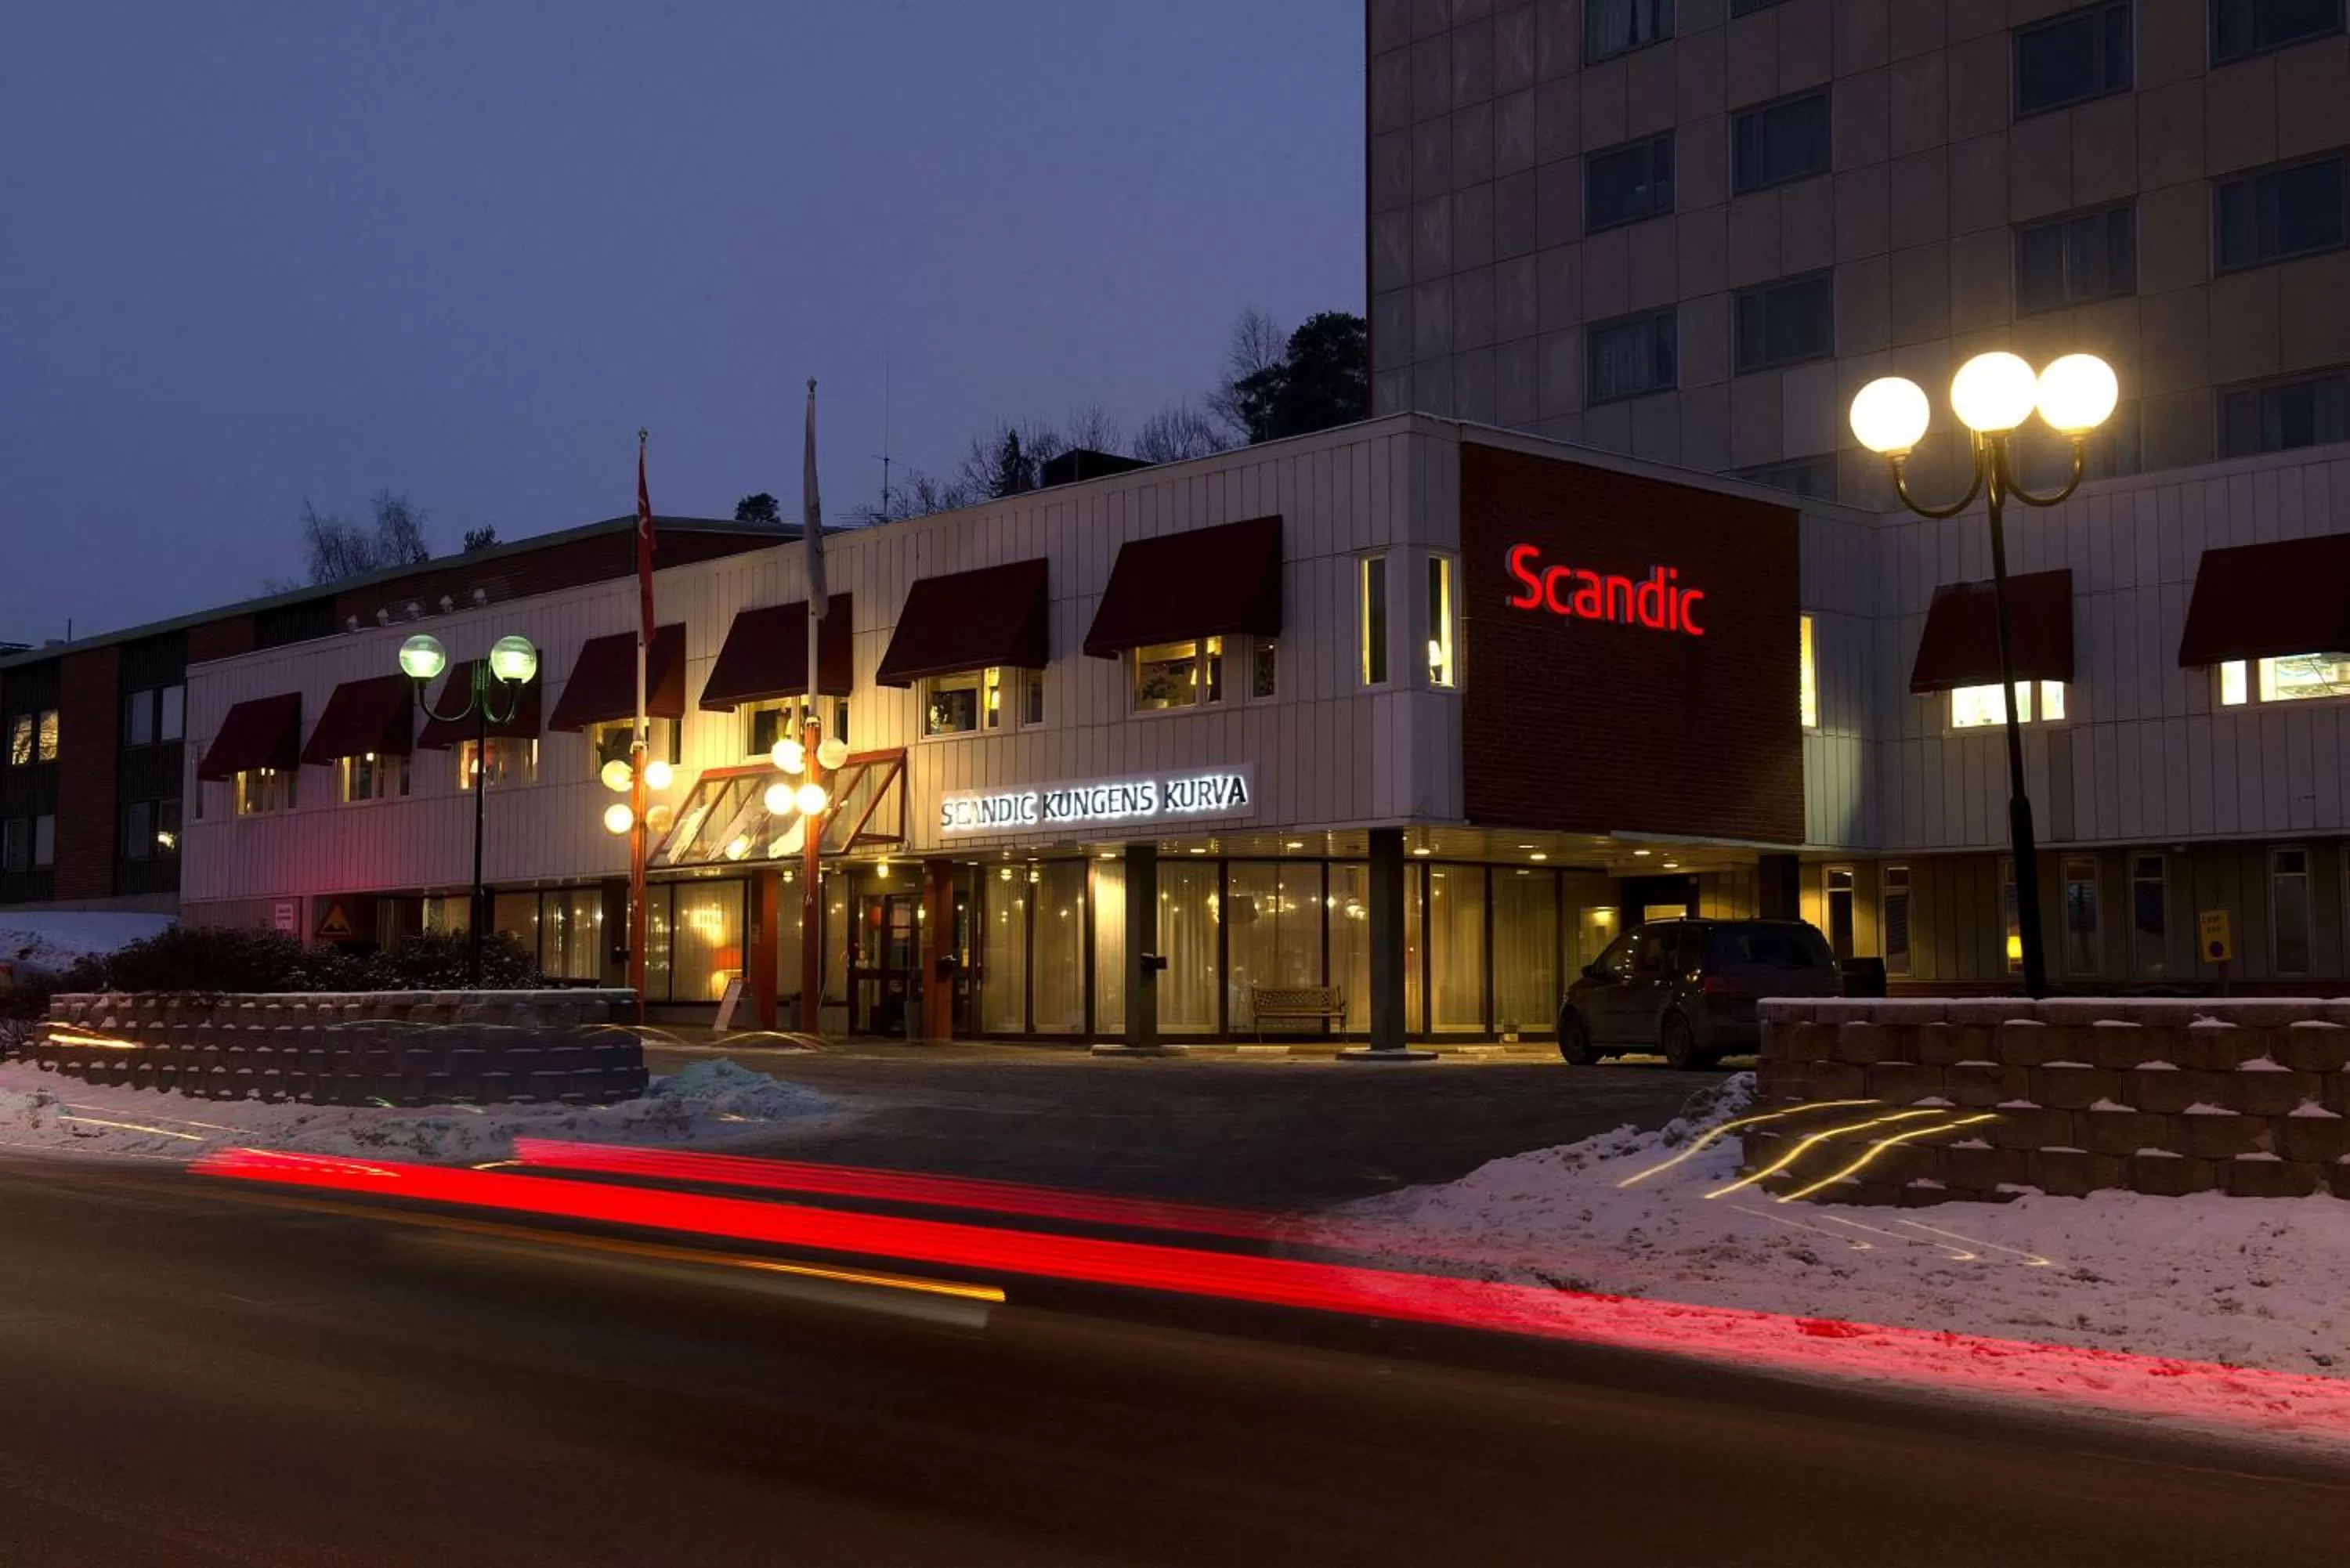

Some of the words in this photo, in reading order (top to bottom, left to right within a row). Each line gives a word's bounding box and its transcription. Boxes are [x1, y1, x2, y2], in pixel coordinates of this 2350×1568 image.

[1506, 544, 1704, 635] Scandic
[940, 795, 1035, 826] SCANDIC
[1043, 786, 1155, 818] KUNGENS
[1164, 777, 1246, 808] KURVA
